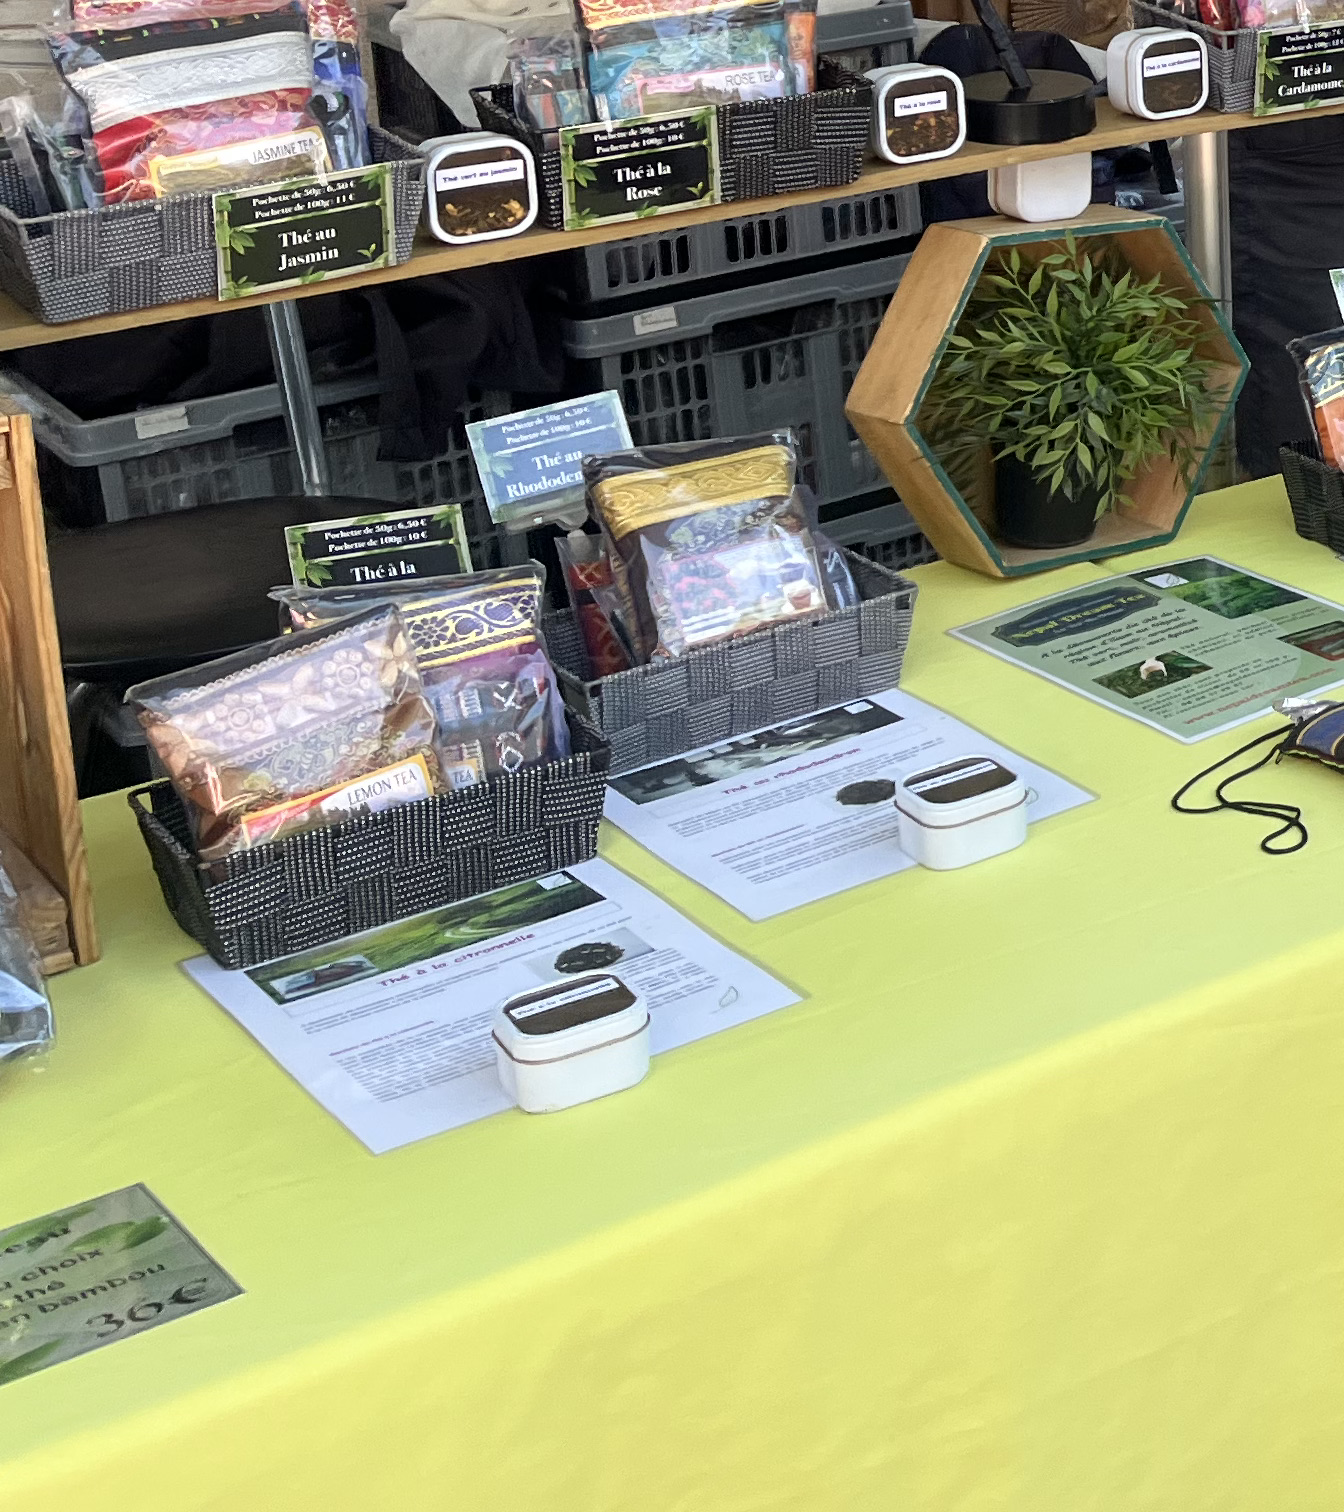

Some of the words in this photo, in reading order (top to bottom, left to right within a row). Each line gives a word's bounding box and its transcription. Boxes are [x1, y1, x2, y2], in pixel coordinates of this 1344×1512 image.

[724, 72, 757, 87] ROSE
[757, 69, 775, 83] TEA
[1291, 64, 1314, 78] Thé
[1322, 62, 1333, 74] la
[1278, 79, 1344, 97] Cardamome
[252, 144, 298, 163] JASMINE
[613, 165, 645, 184] Thé
[645, 164, 656, 178] à
[657, 161, 672, 176] la
[625, 185, 663, 202] Rose
[278, 228, 313, 248] Thé
[315, 226, 337, 240] au
[278, 246, 339, 272] Jasmin
[531, 451, 563, 472] Thé
[564, 449, 583, 464] au
[506, 469, 584, 498] Rhododen
[350, 564, 386, 583] Thé
[388, 562, 398, 577] à
[399, 560, 417, 576] la
[348, 779, 392, 805] LEMON
[395, 768, 417, 787] TEA
[454, 769, 474, 784] TEA
[378, 973, 410, 987] Thé
[38, 1263, 166, 1314] bambou
